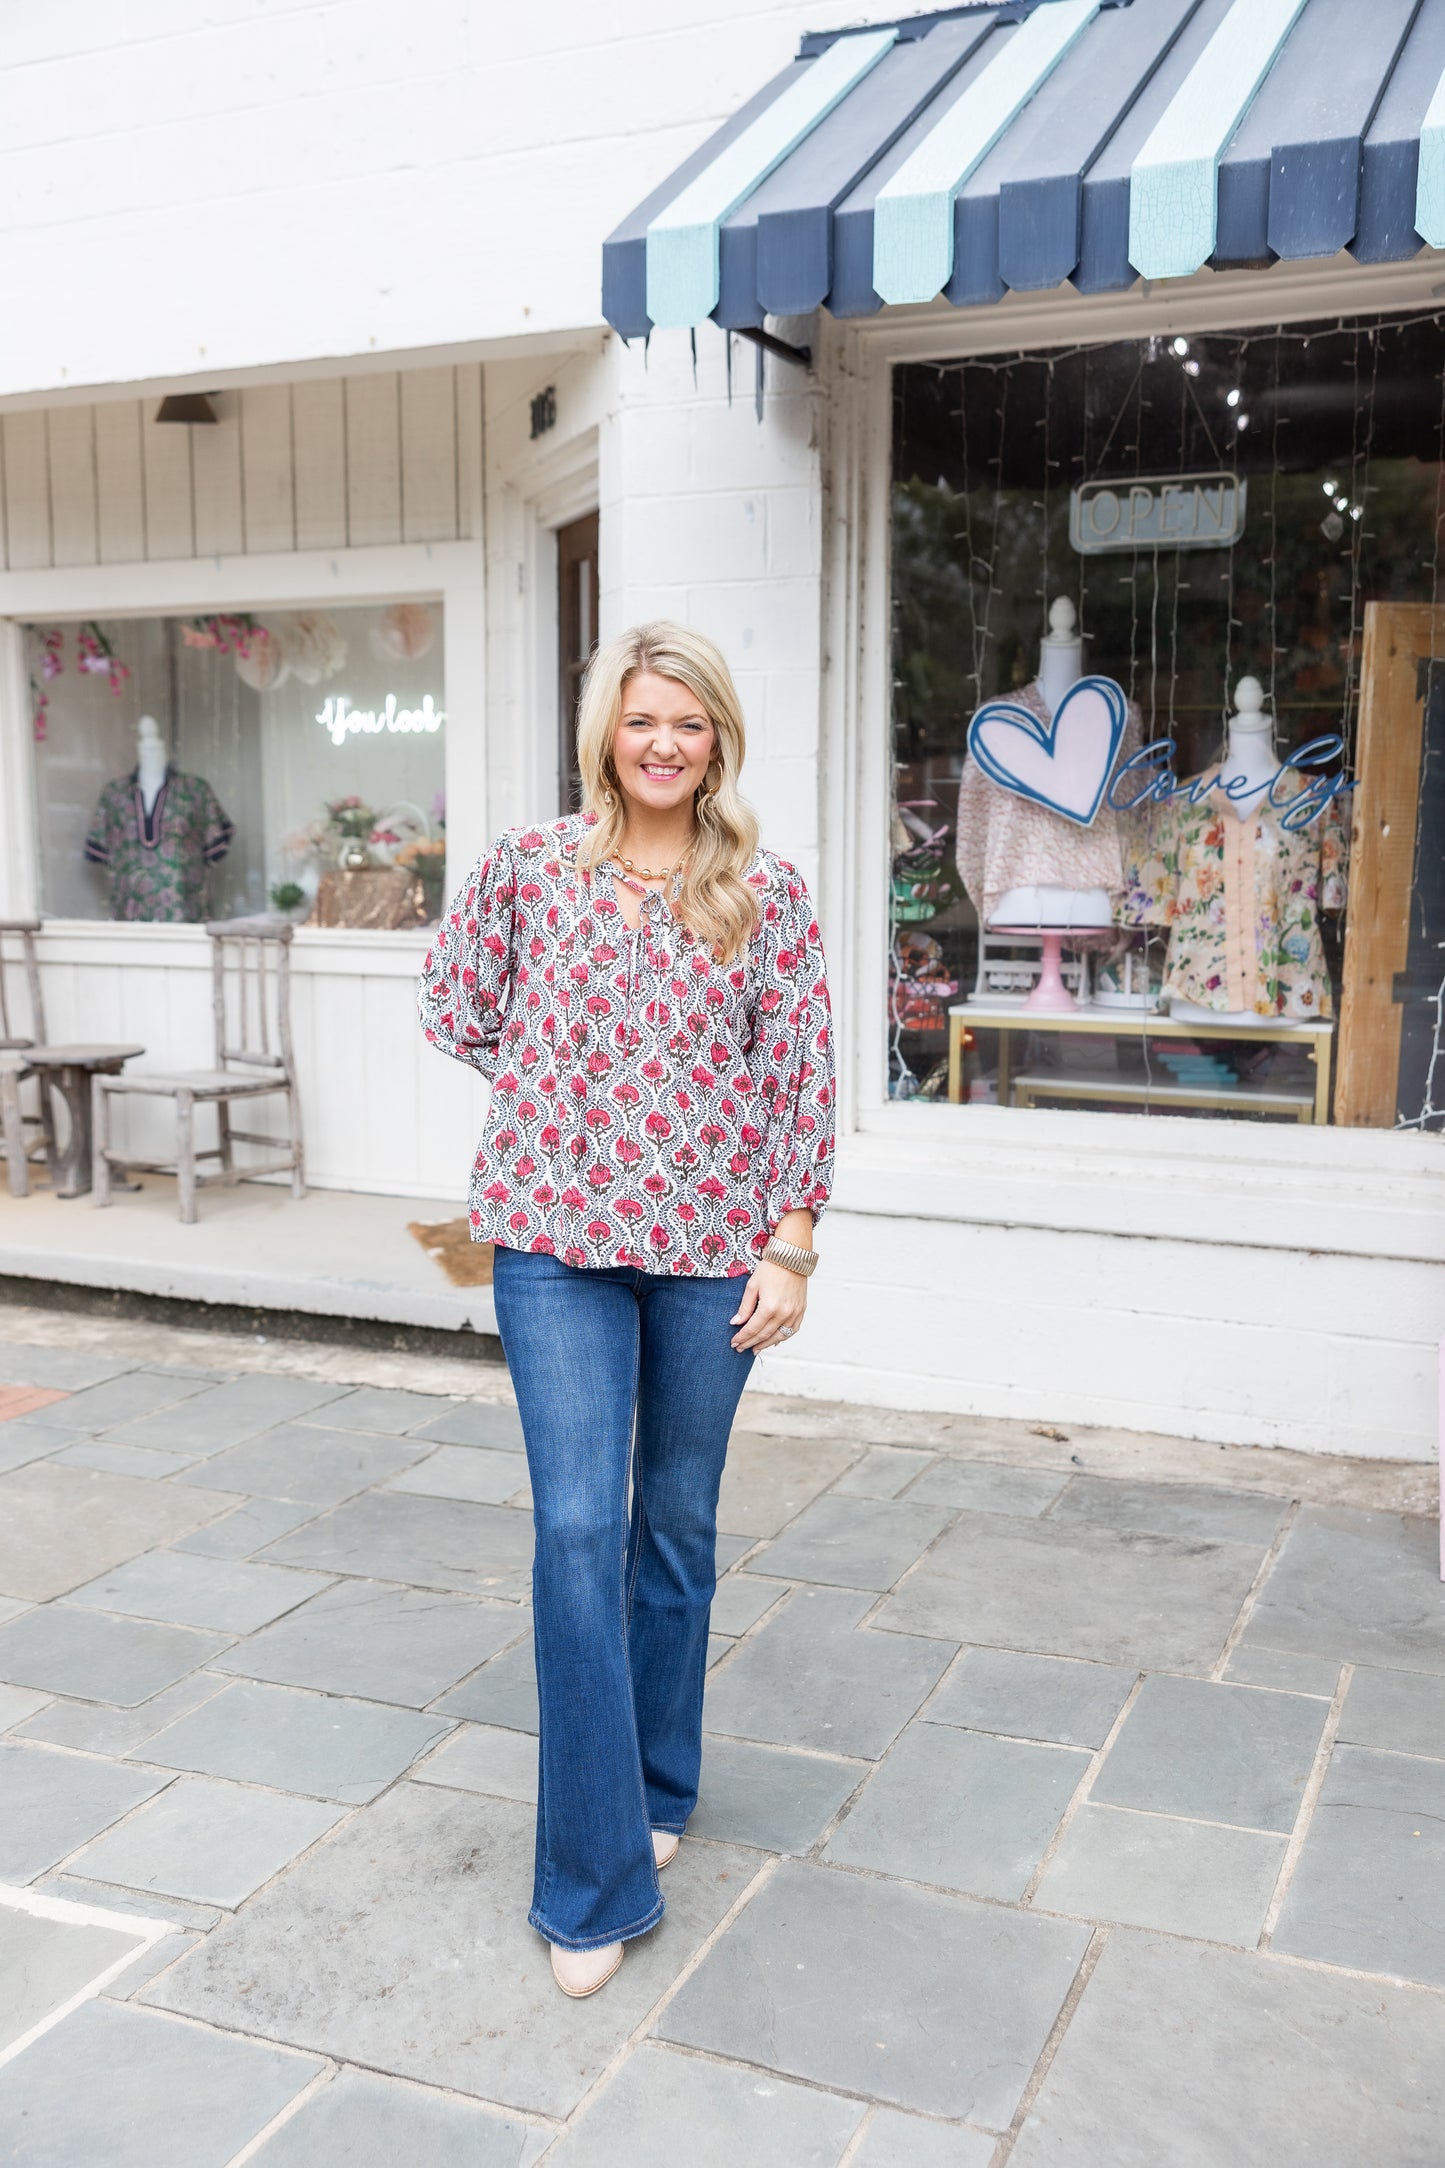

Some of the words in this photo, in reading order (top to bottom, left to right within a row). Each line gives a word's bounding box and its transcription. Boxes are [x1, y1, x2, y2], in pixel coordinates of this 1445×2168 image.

[1089, 482, 1225, 537] OPEN
[315, 697, 385, 746] You
[385, 693, 447, 733] look
